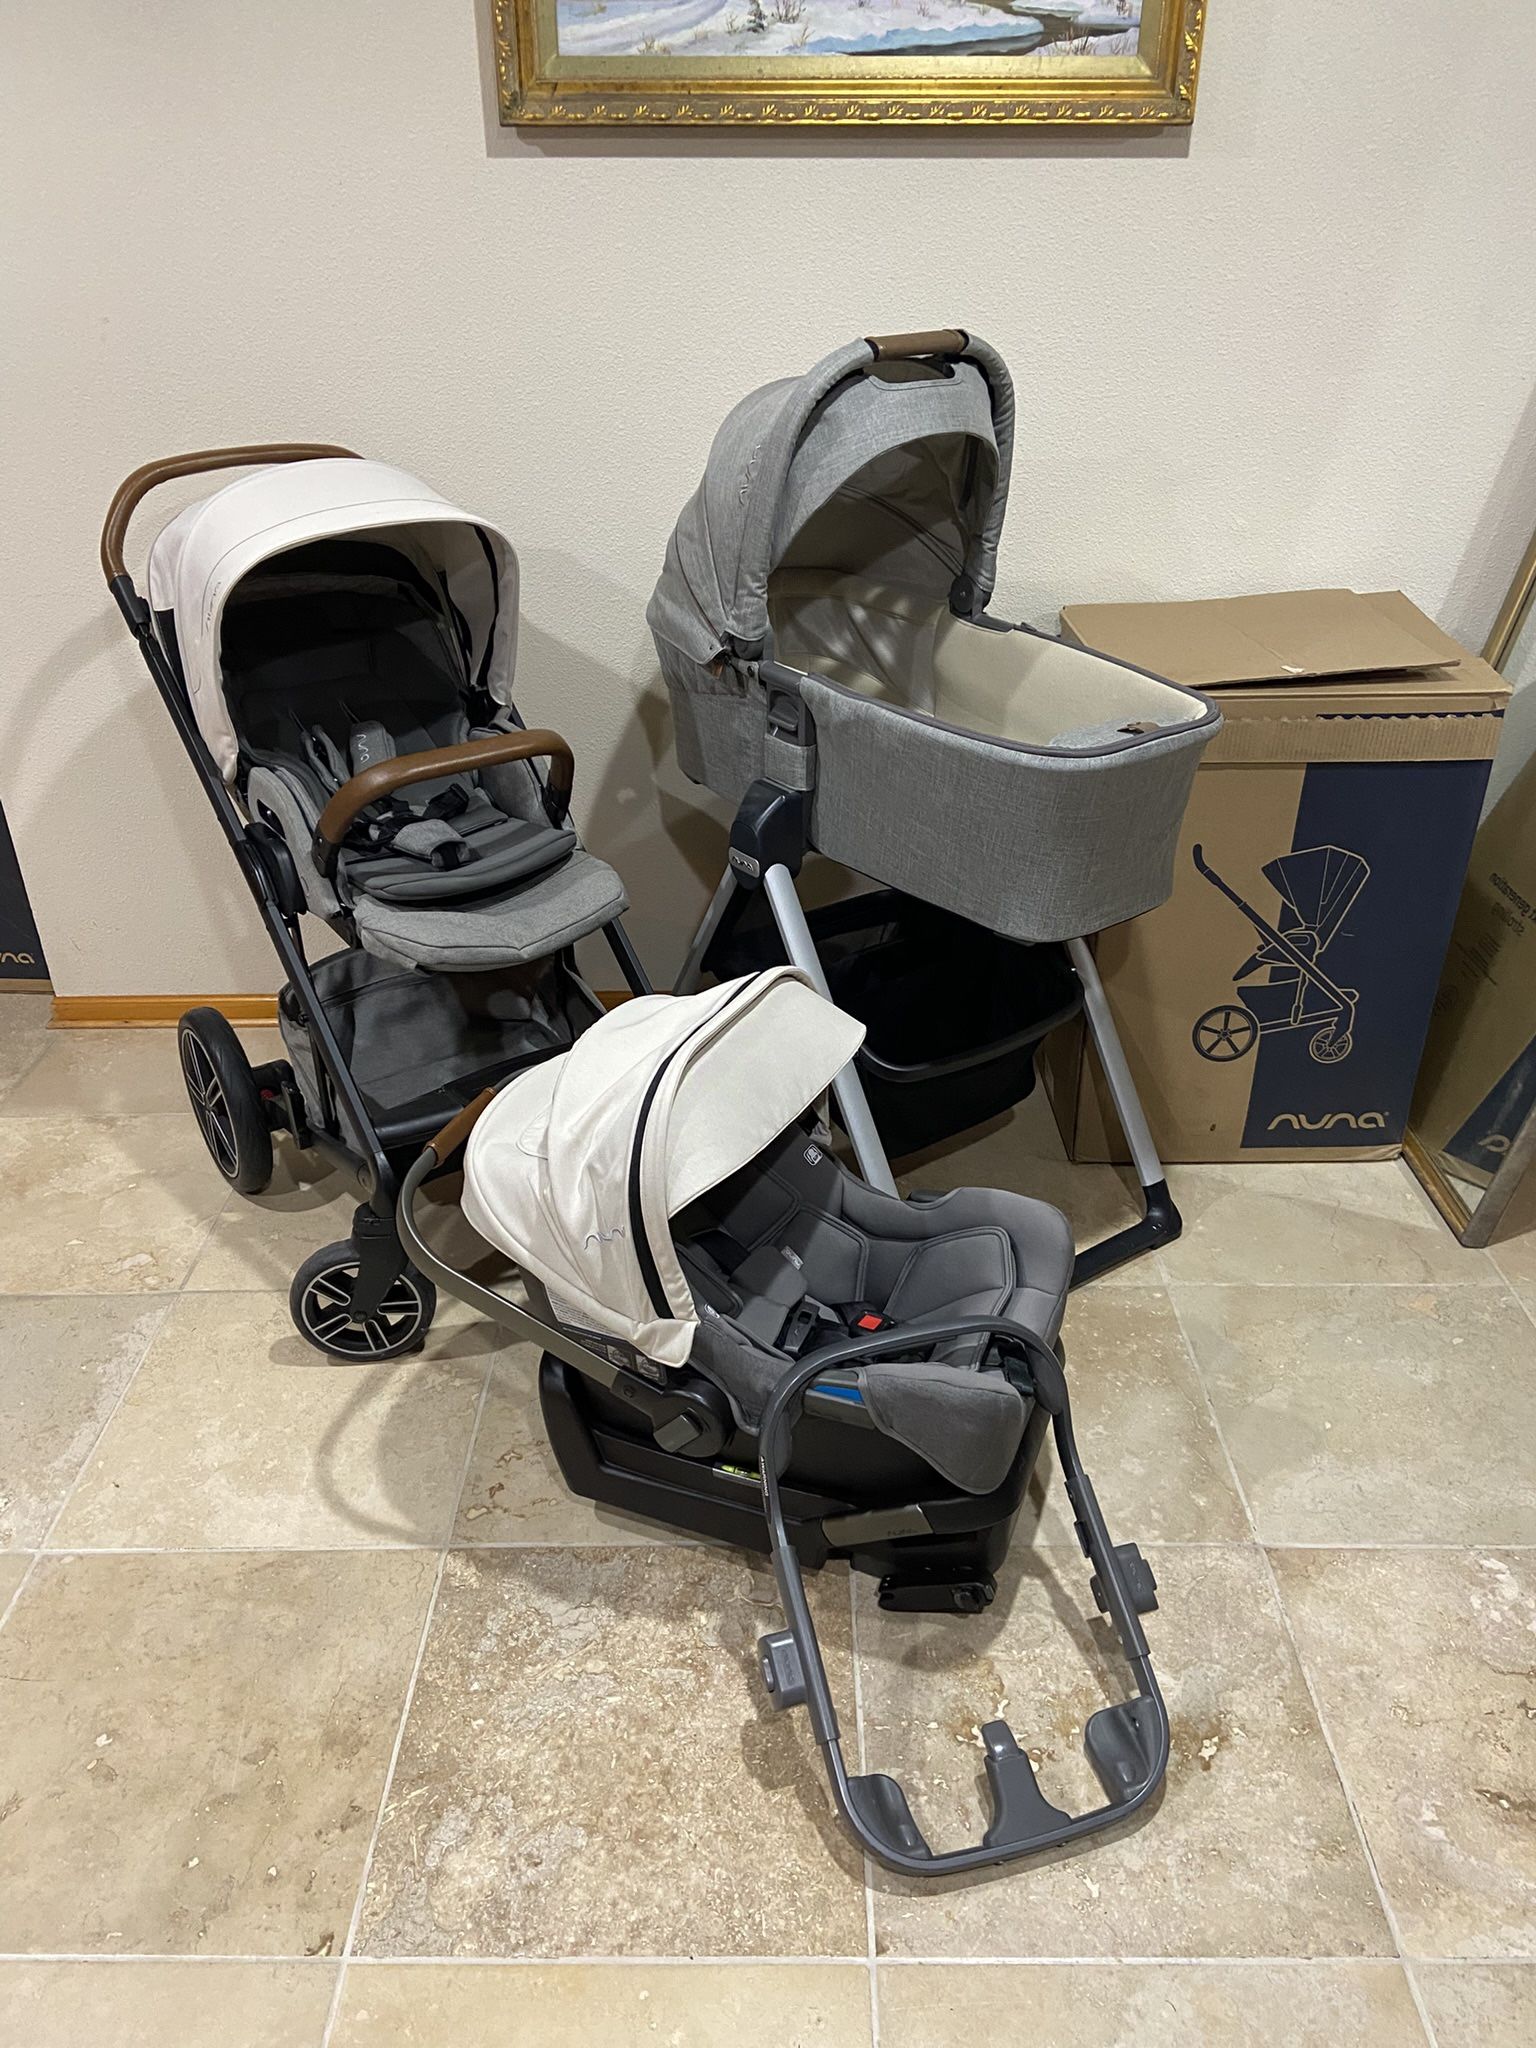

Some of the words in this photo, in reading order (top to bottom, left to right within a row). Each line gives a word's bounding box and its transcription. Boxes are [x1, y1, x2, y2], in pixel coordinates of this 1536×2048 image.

[356, 734, 369, 764] nuna
[0, 952, 35, 964] na
[1267, 1112, 1386, 1130] nuna
